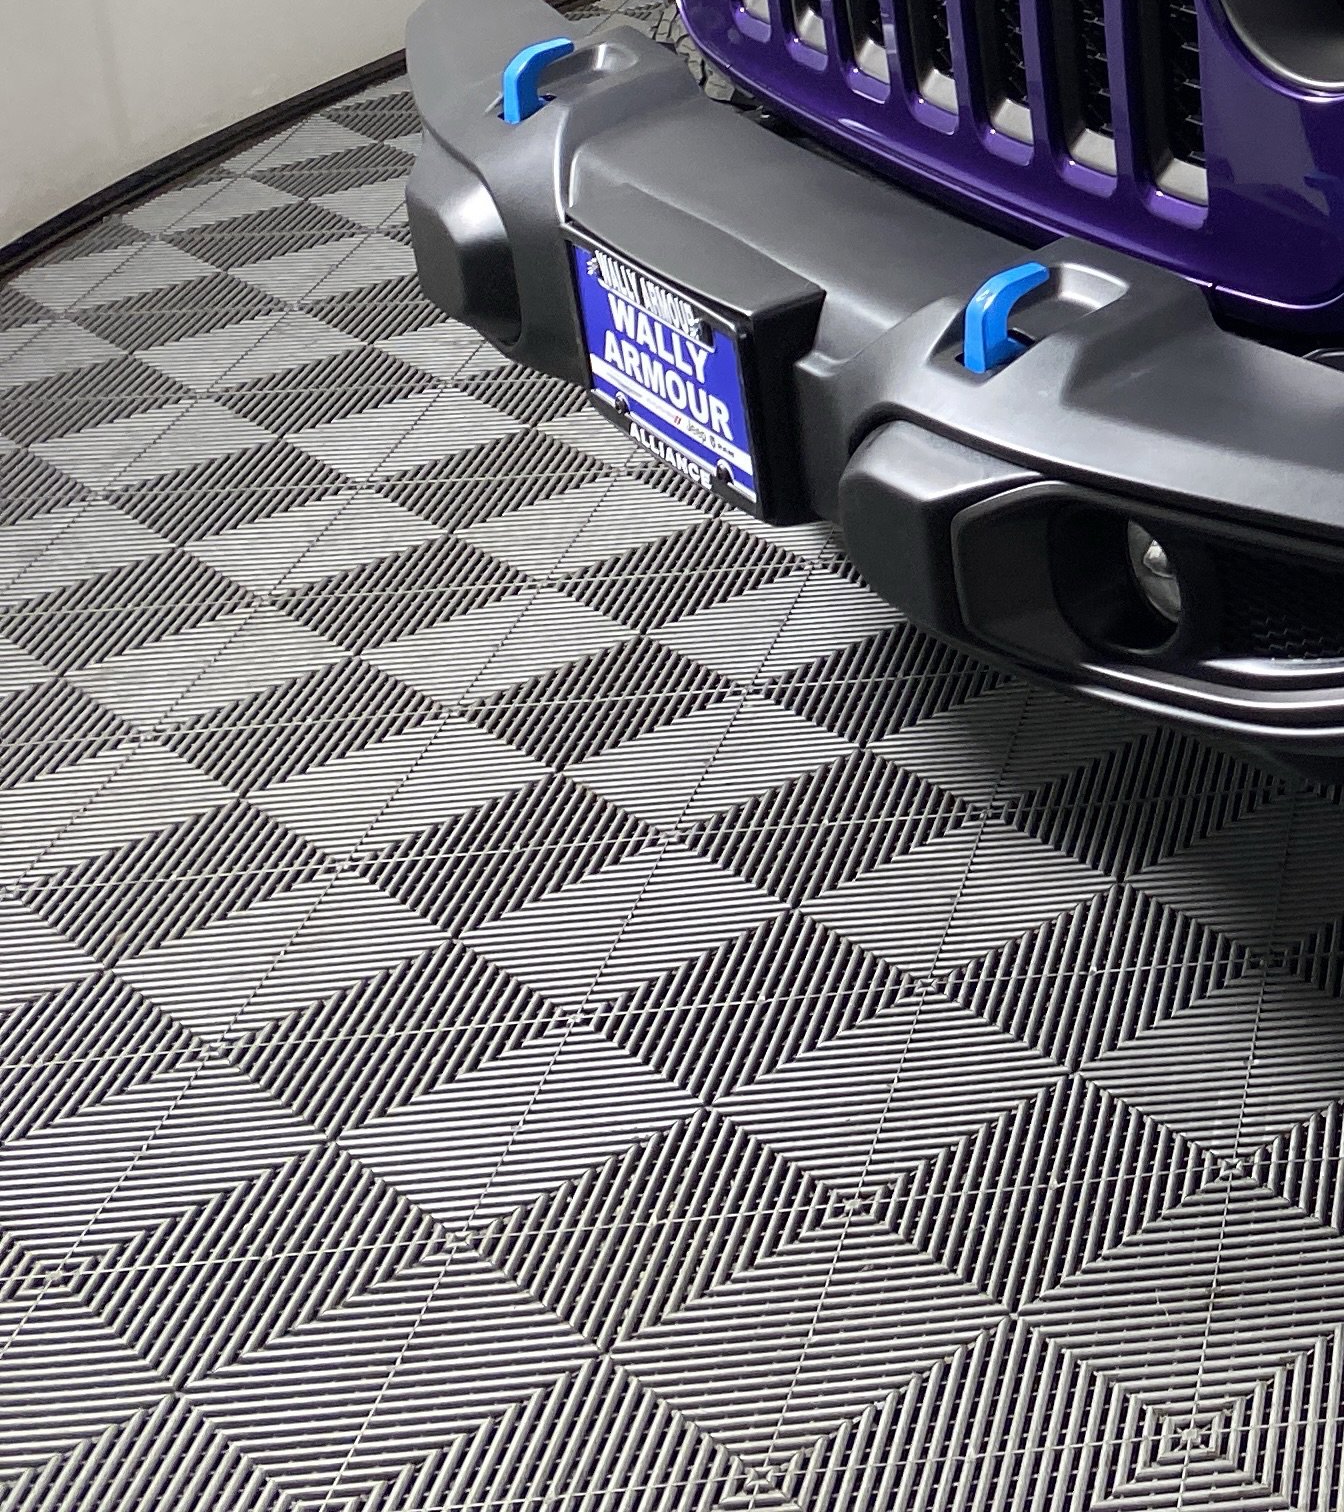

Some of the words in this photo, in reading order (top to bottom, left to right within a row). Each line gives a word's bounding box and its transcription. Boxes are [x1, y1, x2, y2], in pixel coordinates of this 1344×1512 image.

[607, 292, 711, 384] WALLY
[604, 330, 734, 441] ARMOUR
[629, 422, 712, 490] ALLIANCE
